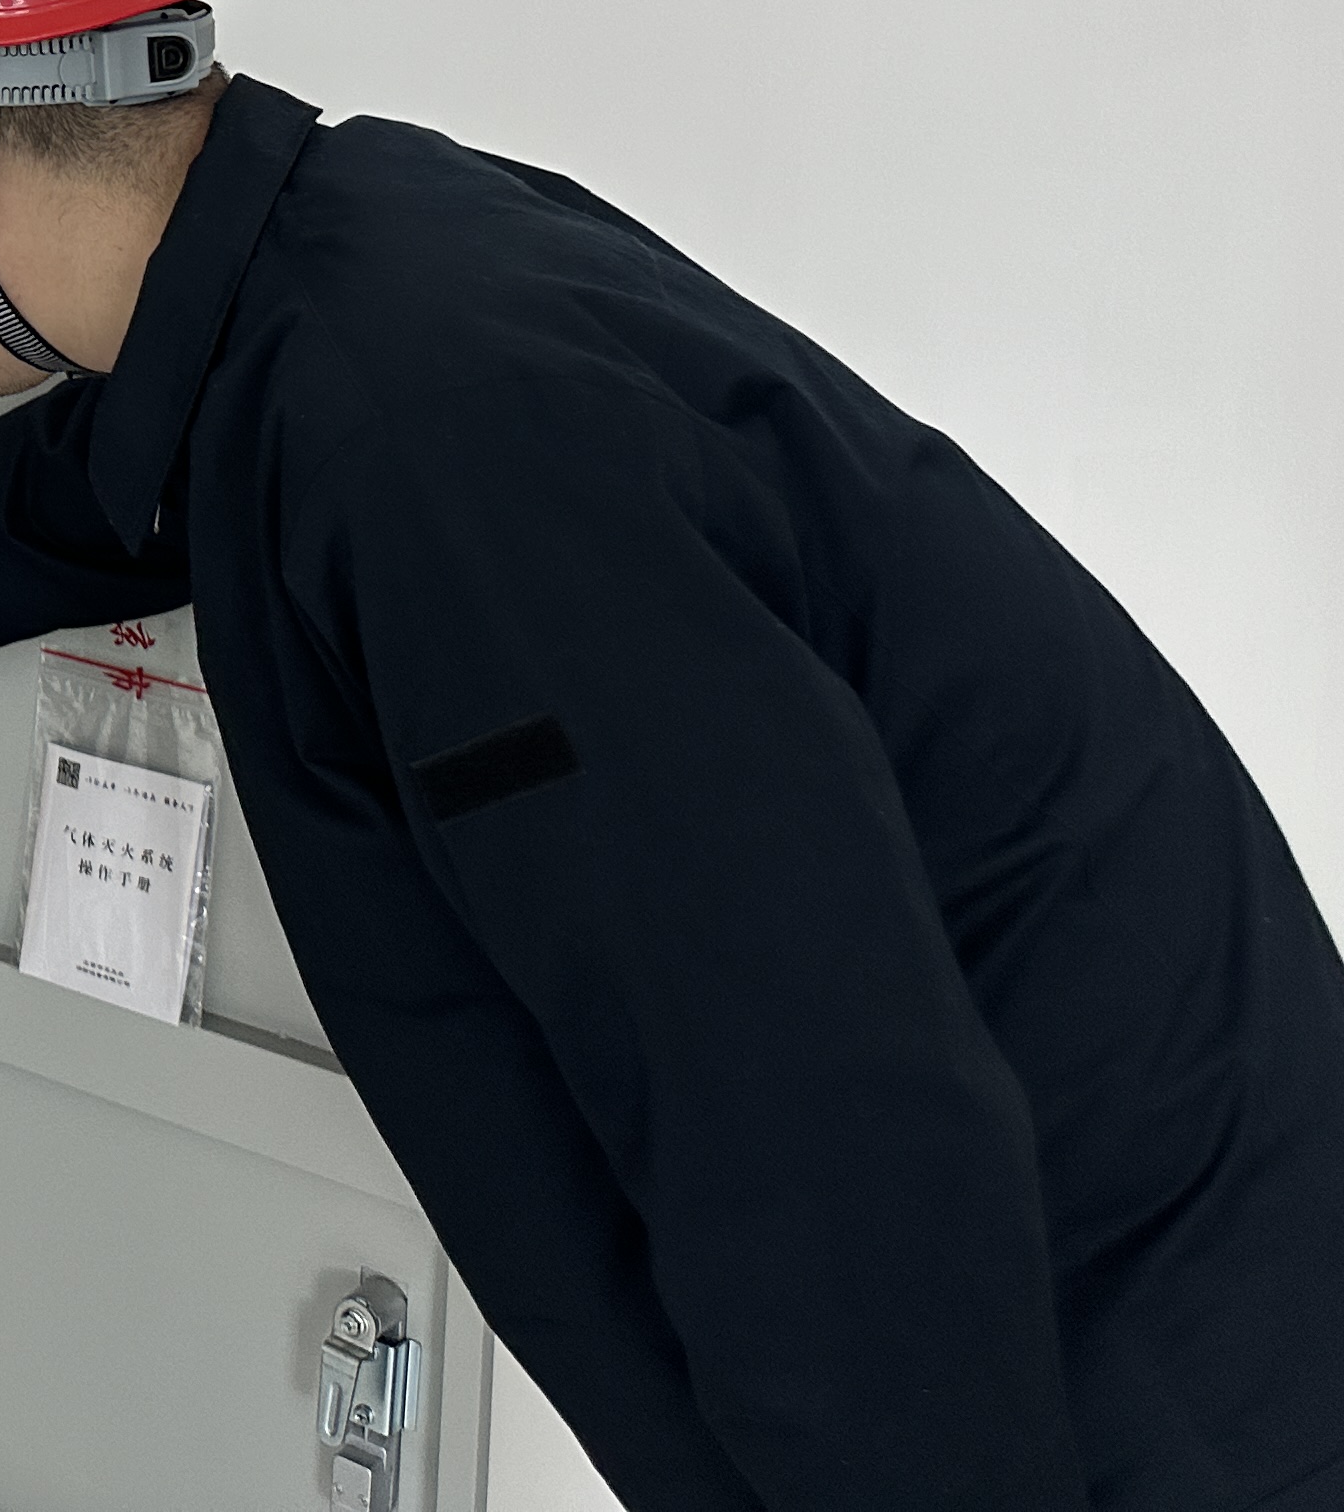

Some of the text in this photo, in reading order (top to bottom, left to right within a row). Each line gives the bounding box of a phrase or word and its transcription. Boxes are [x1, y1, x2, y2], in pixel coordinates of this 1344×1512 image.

[64, 824, 174, 872] 气体灭火系统
[78, 857, 151, 893] 操作手册
